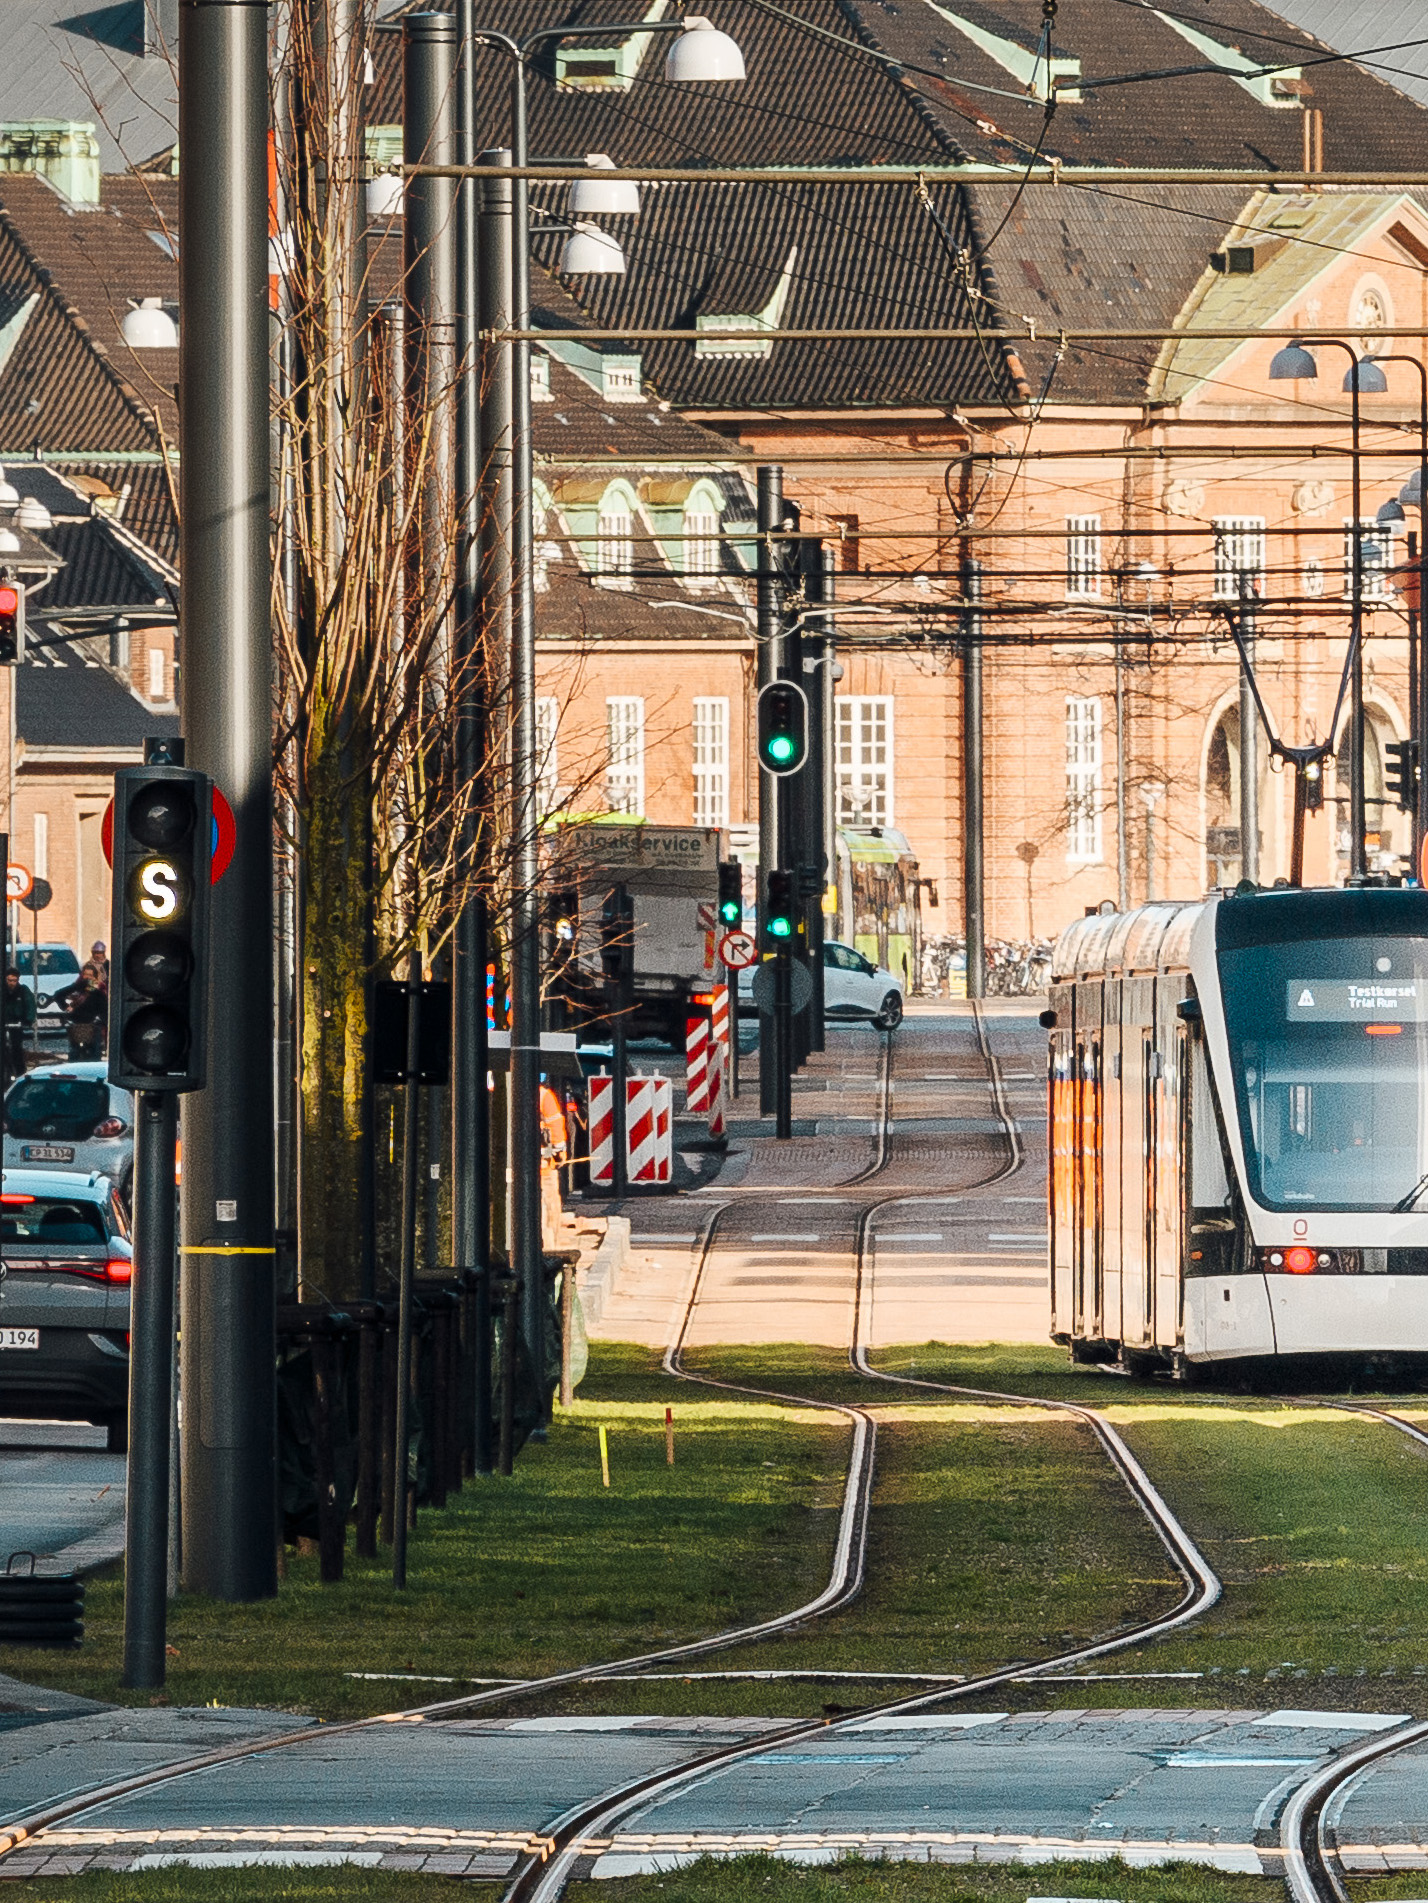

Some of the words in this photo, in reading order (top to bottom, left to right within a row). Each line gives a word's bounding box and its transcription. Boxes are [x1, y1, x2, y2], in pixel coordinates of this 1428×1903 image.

[140, 861, 177, 919] S
[1347, 998, 1375, 1009] Trial
[1377, 998, 1398, 1008] Run
[9, 1331, 36, 1345] 194
